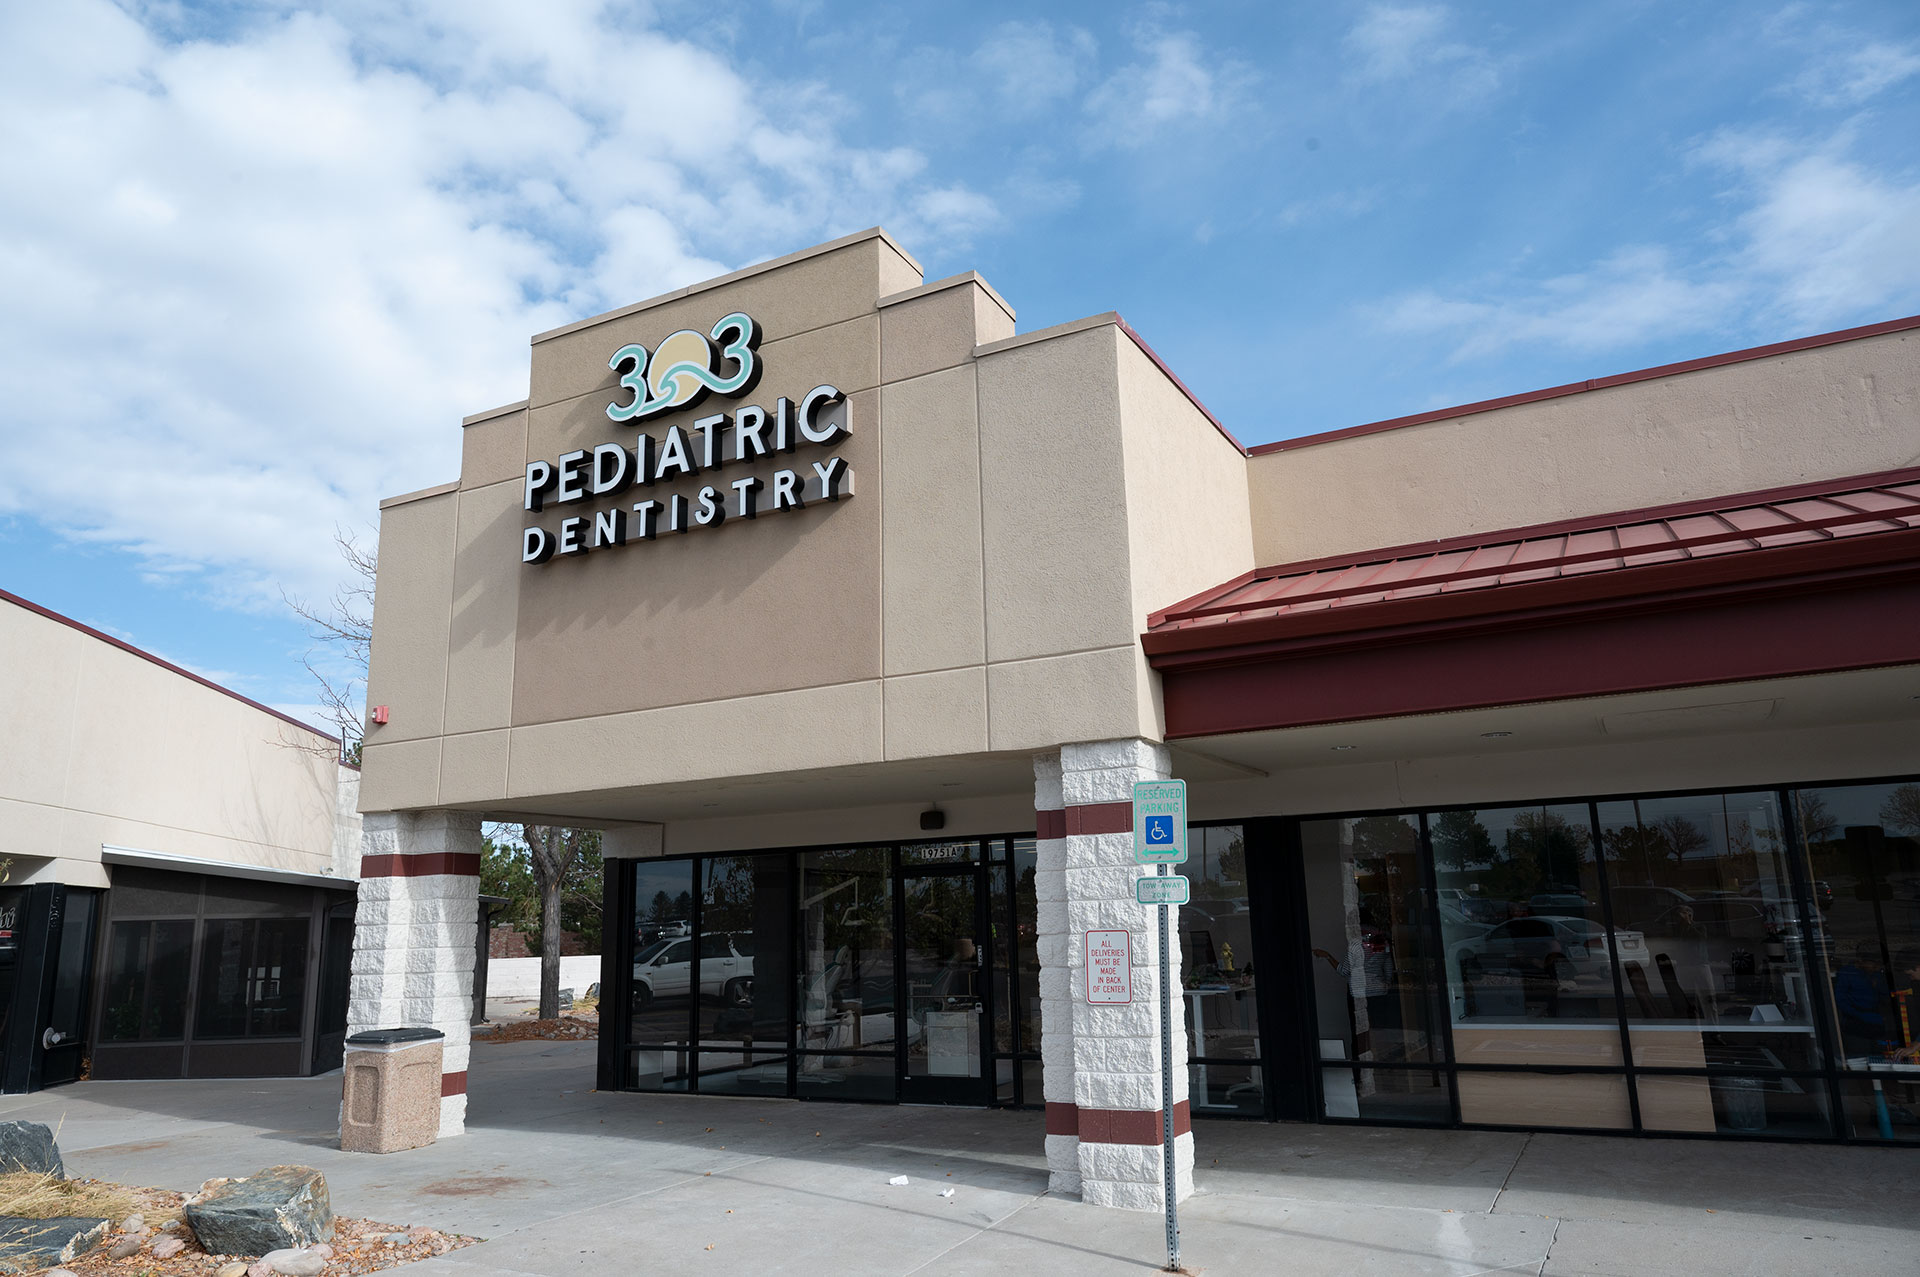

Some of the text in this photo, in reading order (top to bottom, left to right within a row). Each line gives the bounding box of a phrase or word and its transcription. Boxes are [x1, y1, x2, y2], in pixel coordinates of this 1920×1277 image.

[605, 311, 762, 425] 303
[524, 384, 851, 512] PEDIATRIC
[522, 457, 849, 564] DENTISTRY
[1137, 788, 1182, 800] RESERVED
[1140, 802, 1179, 814] PARKING
[921, 847, 957, 858] 19751A
[1101, 940, 1112, 948] ALL
[1091, 949, 1125, 957] DELIVERIES
[1095, 958, 1121, 966] MUST BE
[1100, 967, 1117, 975] MADE
[1097, 976, 1122, 984] IN BACK
[1092, 985, 1126, 993] OF CENTER
